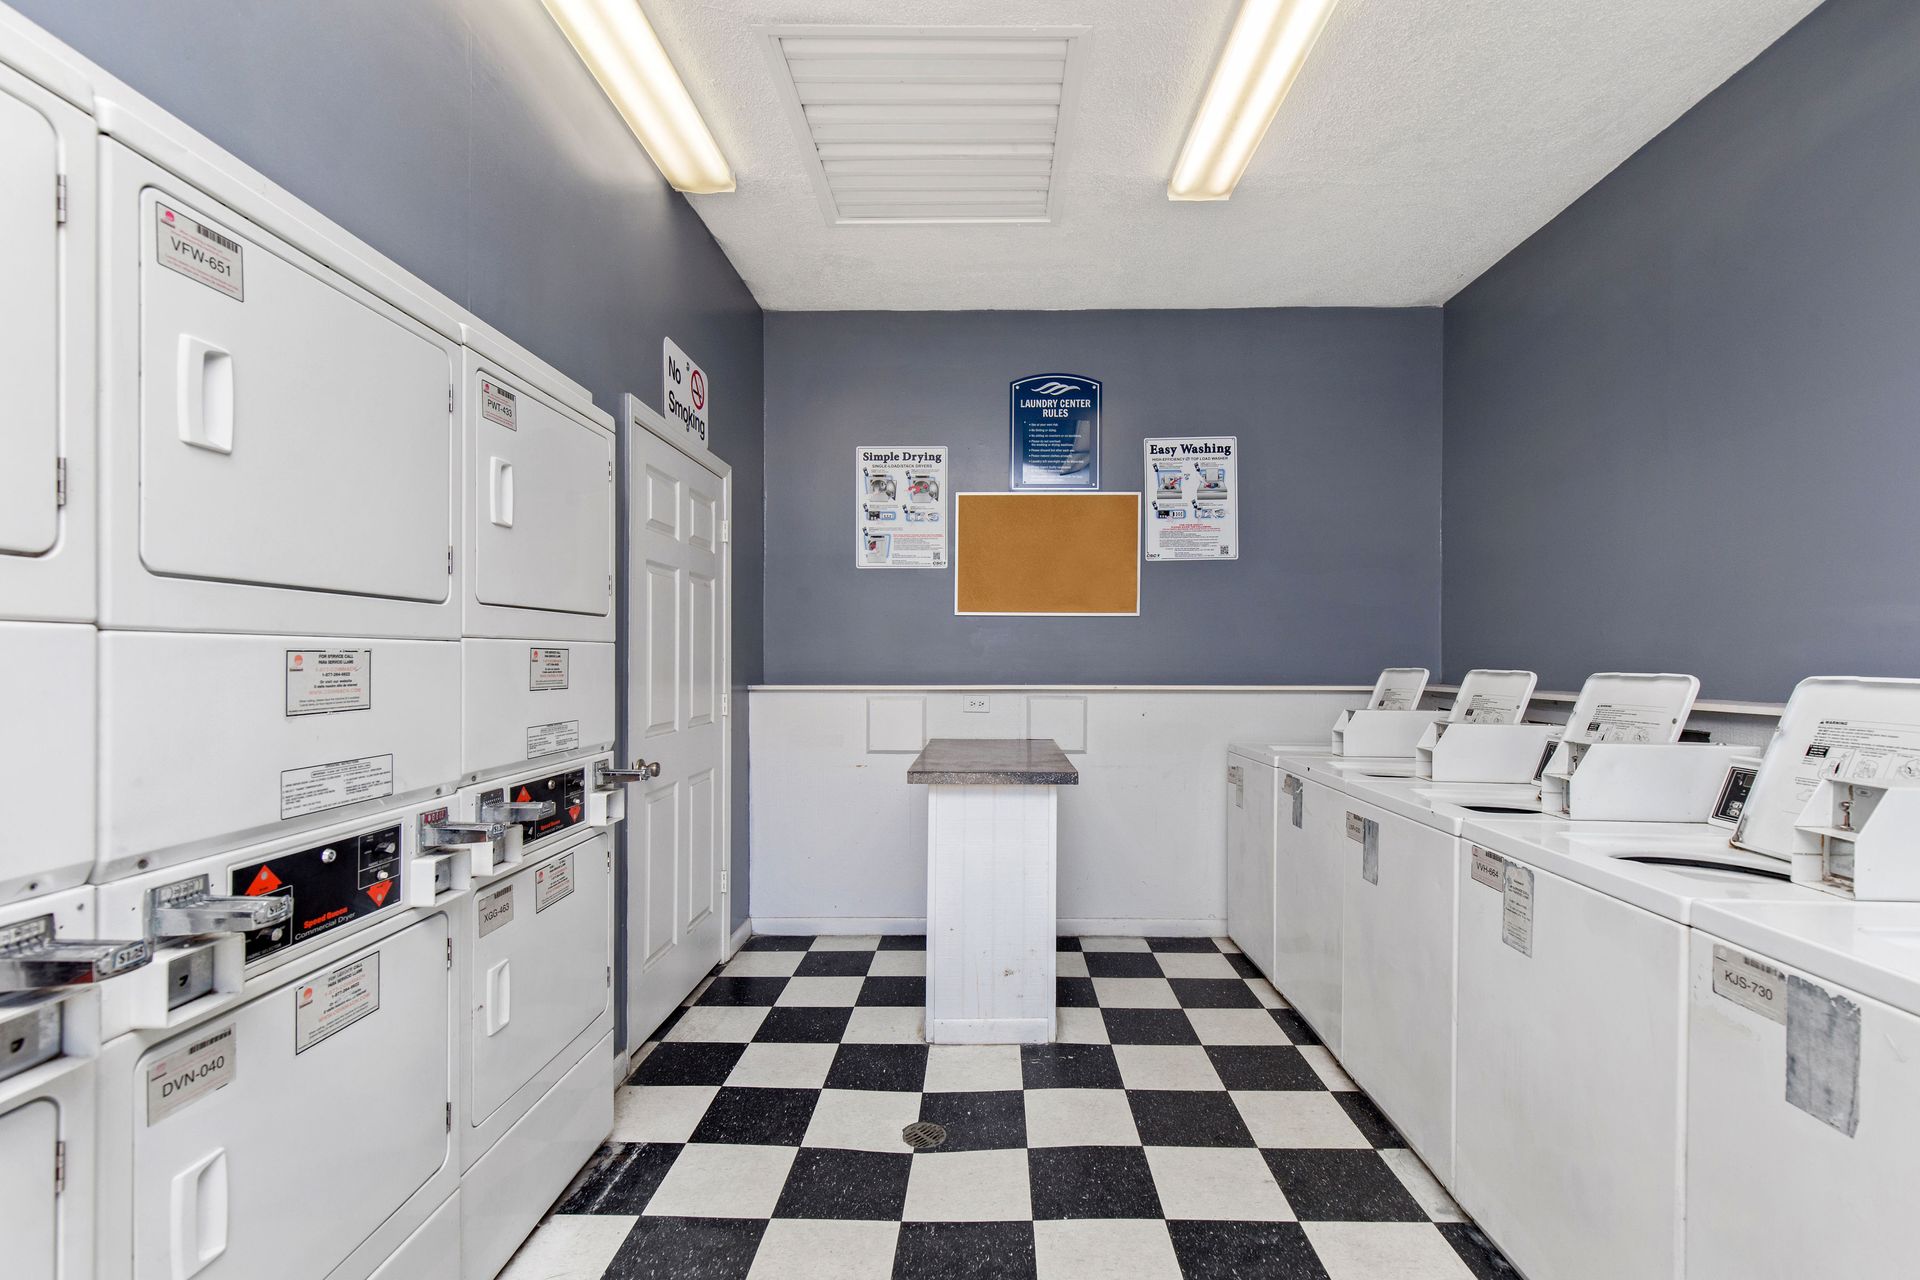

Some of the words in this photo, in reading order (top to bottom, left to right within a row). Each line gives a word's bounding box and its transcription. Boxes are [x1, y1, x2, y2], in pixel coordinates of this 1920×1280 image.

[170, 236, 230, 276] VFW-651
[669, 356, 681, 384] No
[668, 390, 705, 441] Smoking
[1020, 399, 1057, 408] LAUNDRY
[1060, 399, 1091, 408] CENTER
[1042, 409, 1069, 417] RULES
[863, 452, 899, 463] Simple
[903, 452, 942, 463] Drying
[1150, 444, 1177, 457] Easy
[1180, 443, 1231, 456] Washing
[294, 919, 336, 940] Commercial
[338, 912, 355, 923] Dryer
[304, 914, 326, 928] Speed
[327, 906, 348, 919] Queen
[1725, 970, 1772, 1000] KJS-730
[162, 1055, 224, 1098] DVN-040
